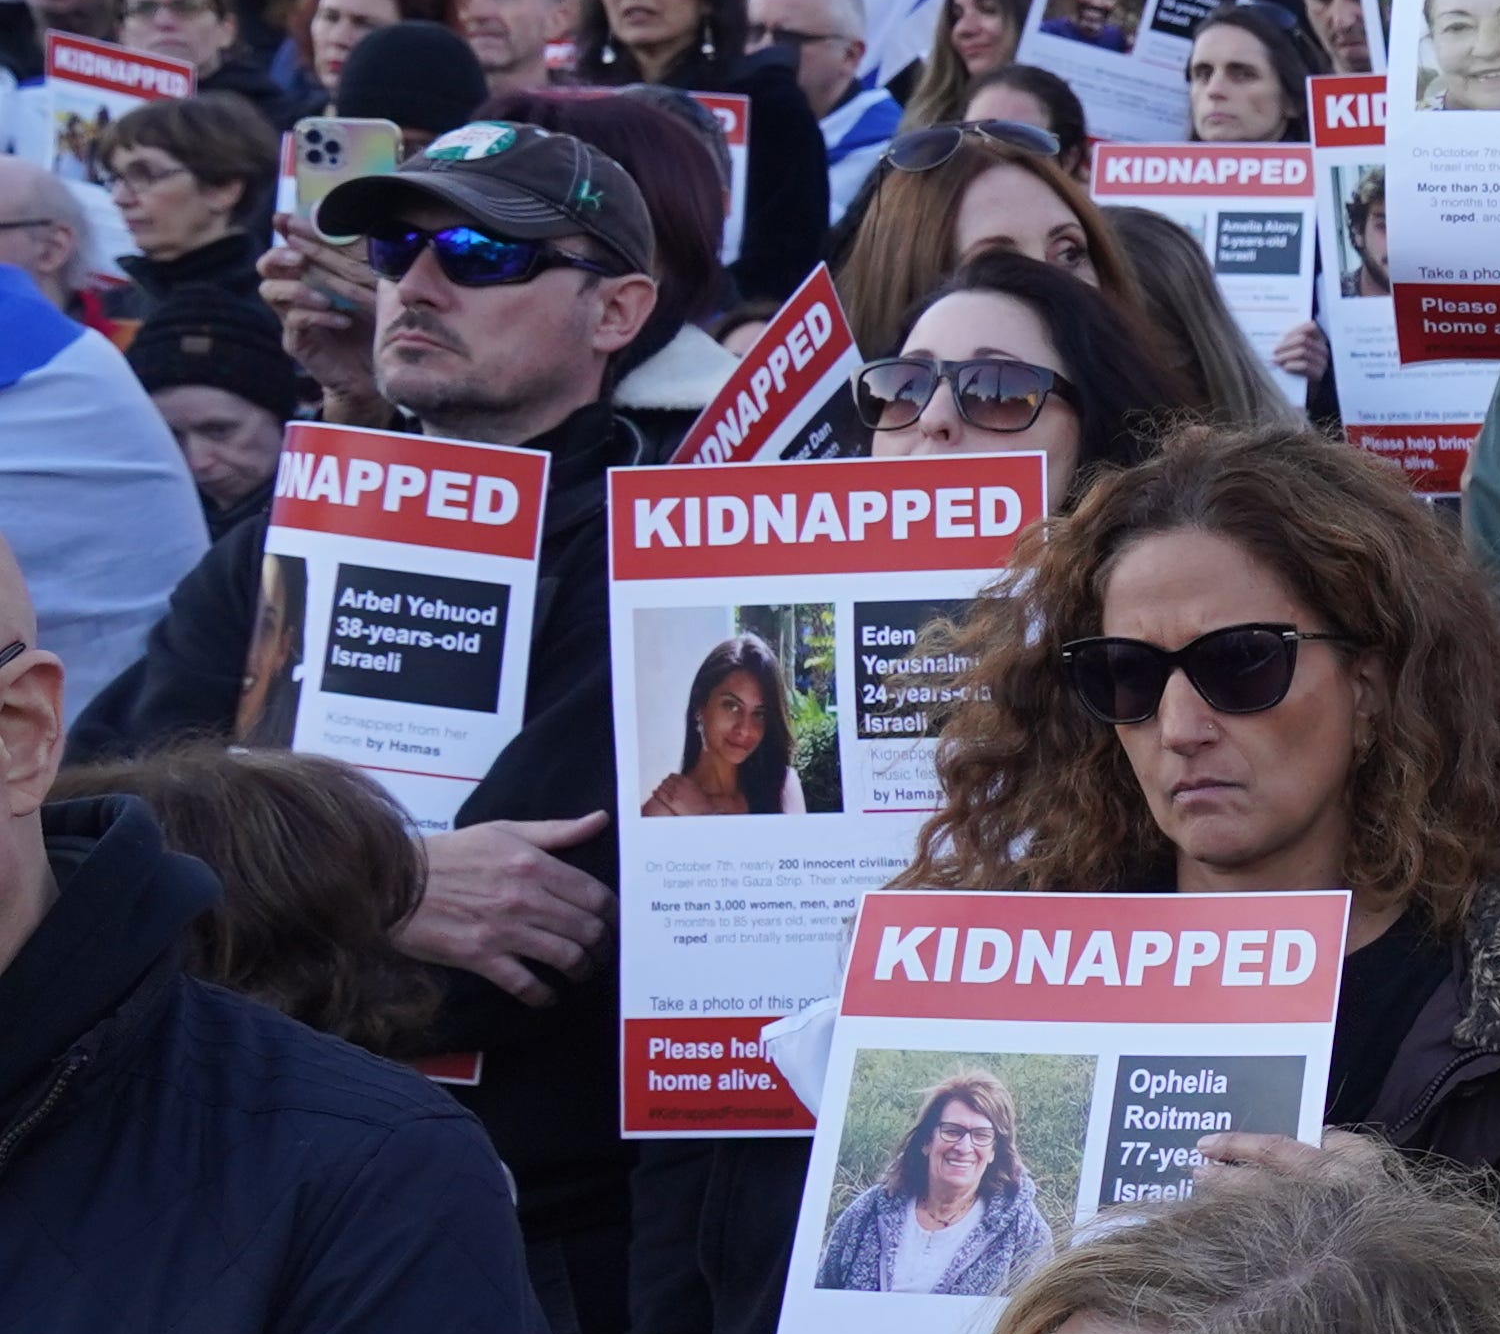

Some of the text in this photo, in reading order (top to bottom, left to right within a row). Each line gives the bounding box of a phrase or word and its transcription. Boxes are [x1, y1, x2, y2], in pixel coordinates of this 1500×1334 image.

[1105, 156, 1307, 186] KIDNAPPED
[1421, 298, 1497, 315] Please
[1424, 319, 1485, 336] home
[275, 451, 520, 526] DNAPPED
[633, 485, 1023, 550] KIDNAPPED
[339, 587, 498, 627] Arbel Yehuod
[335, 616, 481, 655] 38-years-old
[862, 626, 915, 647] Eden
[332, 645, 402, 674] Israeli
[864, 711, 928, 733] Israeli
[366, 736, 441, 758] by Hamas
[874, 788, 944, 802] by Hamas
[873, 925, 1318, 988] KIDNAPPED
[649, 1037, 725, 1062] Please
[649, 1069, 778, 1092] home alive.
[1129, 1069, 1228, 1100] Ophelia
[1123, 1104, 1232, 1131] Roitman
[1120, 1142, 1209, 1173] 77-yea
[1113, 1178, 1195, 1203] Israeli
